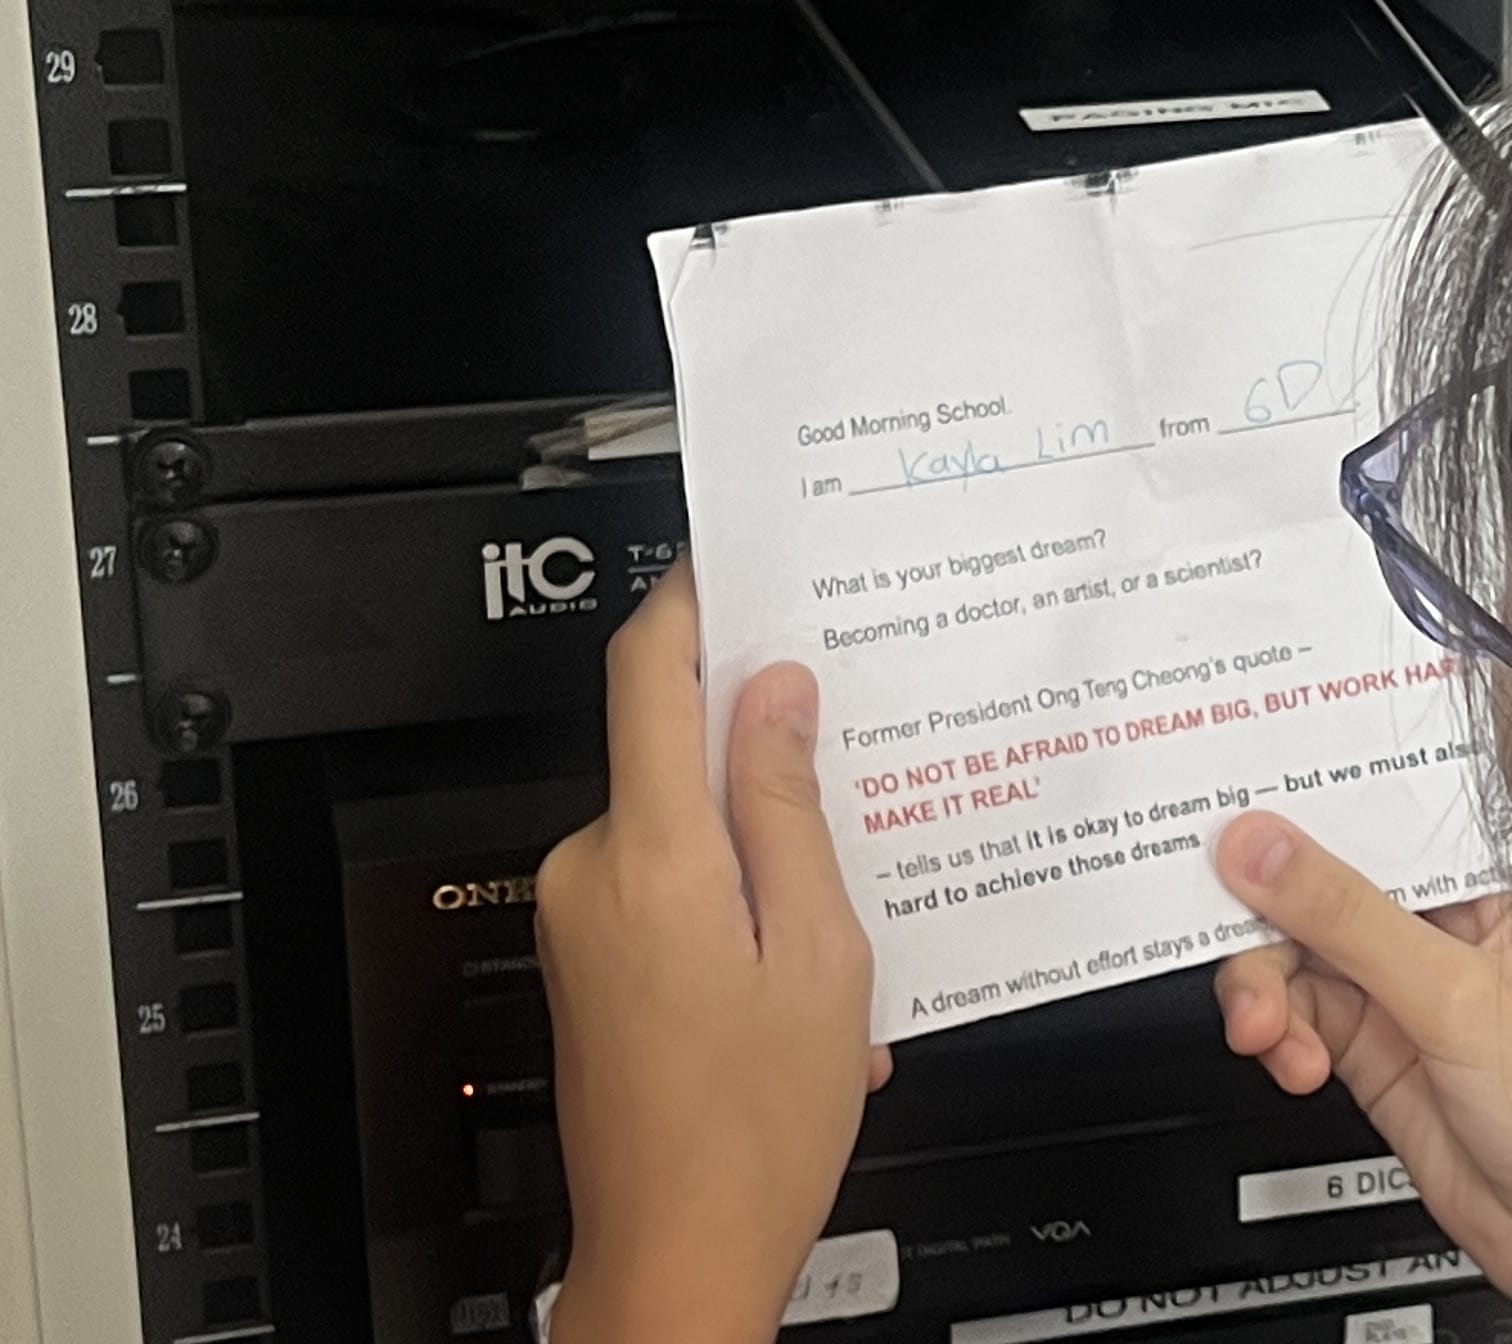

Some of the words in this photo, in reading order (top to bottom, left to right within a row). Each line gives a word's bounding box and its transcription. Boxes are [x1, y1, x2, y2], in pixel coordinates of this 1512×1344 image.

[46, 50, 75, 83] 29
[68, 303, 97, 335] 28
[797, 420, 845, 446] Good
[849, 411, 931, 436] Morning
[935, 396, 1011, 424] School.
[812, 477, 842, 496] am
[1159, 417, 1210, 437] from
[89, 546, 116, 578] 27
[811, 573, 868, 599] What
[871, 568, 891, 588] is
[895, 562, 942, 590] your
[946, 545, 1026, 575] biggest
[1029, 528, 1105, 559] dream?
[509, 598, 599, 617] AUDIO
[822, 615, 929, 649] Becoming
[935, 611, 948, 629] a
[954, 597, 1026, 624] doctor,
[1032, 590, 1059, 609] an
[1063, 578, 1115, 603] artist,
[1120, 575, 1140, 593] or
[1145, 572, 1158, 588] a
[1163, 549, 1261, 584] scientist?
[841, 720, 921, 750] Former
[927, 695, 1032, 731] President
[1036, 687, 1080, 709] Ong
[1081, 678, 1127, 699] Teng
[1232, 645, 1292, 672] quote
[905, 759, 955, 788] NOT
[963, 751, 998, 775] BE
[1005, 732, 1088, 766] AFRAID
[1092, 725, 1120, 747] TO
[1124, 708, 1204, 741] DREAM
[1210, 699, 1258, 723] BIG,
[1264, 685, 1311, 712] BUT
[1317, 670, 1398, 700] WORK
[110, 780, 138, 811] 26
[863, 800, 937, 833] MAKE
[942, 793, 962, 817] IT
[896, 855, 941, 879] tells
[947, 849, 974, 867] us
[979, 835, 1022, 860] that
[1025, 829, 1043, 850] it
[1046, 825, 1067, 845] is
[1072, 816, 1118, 838] okay
[1122, 809, 1144, 827] to
[1148, 797, 1211, 821] dream
[1215, 786, 1252, 811] big
[1283, 769, 1323, 792] but
[1327, 764, 1361, 782] we
[1368, 748, 1428, 774] must
[883, 889, 939, 918] hard
[943, 886, 968, 905] to
[975, 866, 1062, 897] achieve
[1067, 850, 1125, 875] those
[1411, 875, 1457, 897] with
[911, 996, 929, 1019] A
[930, 983, 1001, 1012] dream
[1004, 960, 1081, 993] without
[1086, 946, 1138, 974] effort
[1142, 935, 1194, 960] stays
[1197, 930, 1210, 946] a
[138, 1003, 166, 1034] 25
[1326, 1175, 1344, 1200] 6
[157, 1223, 182, 1252] 24
[1064, 1297, 1126, 1324] DO
[1140, 1284, 1221, 1314] NOT
